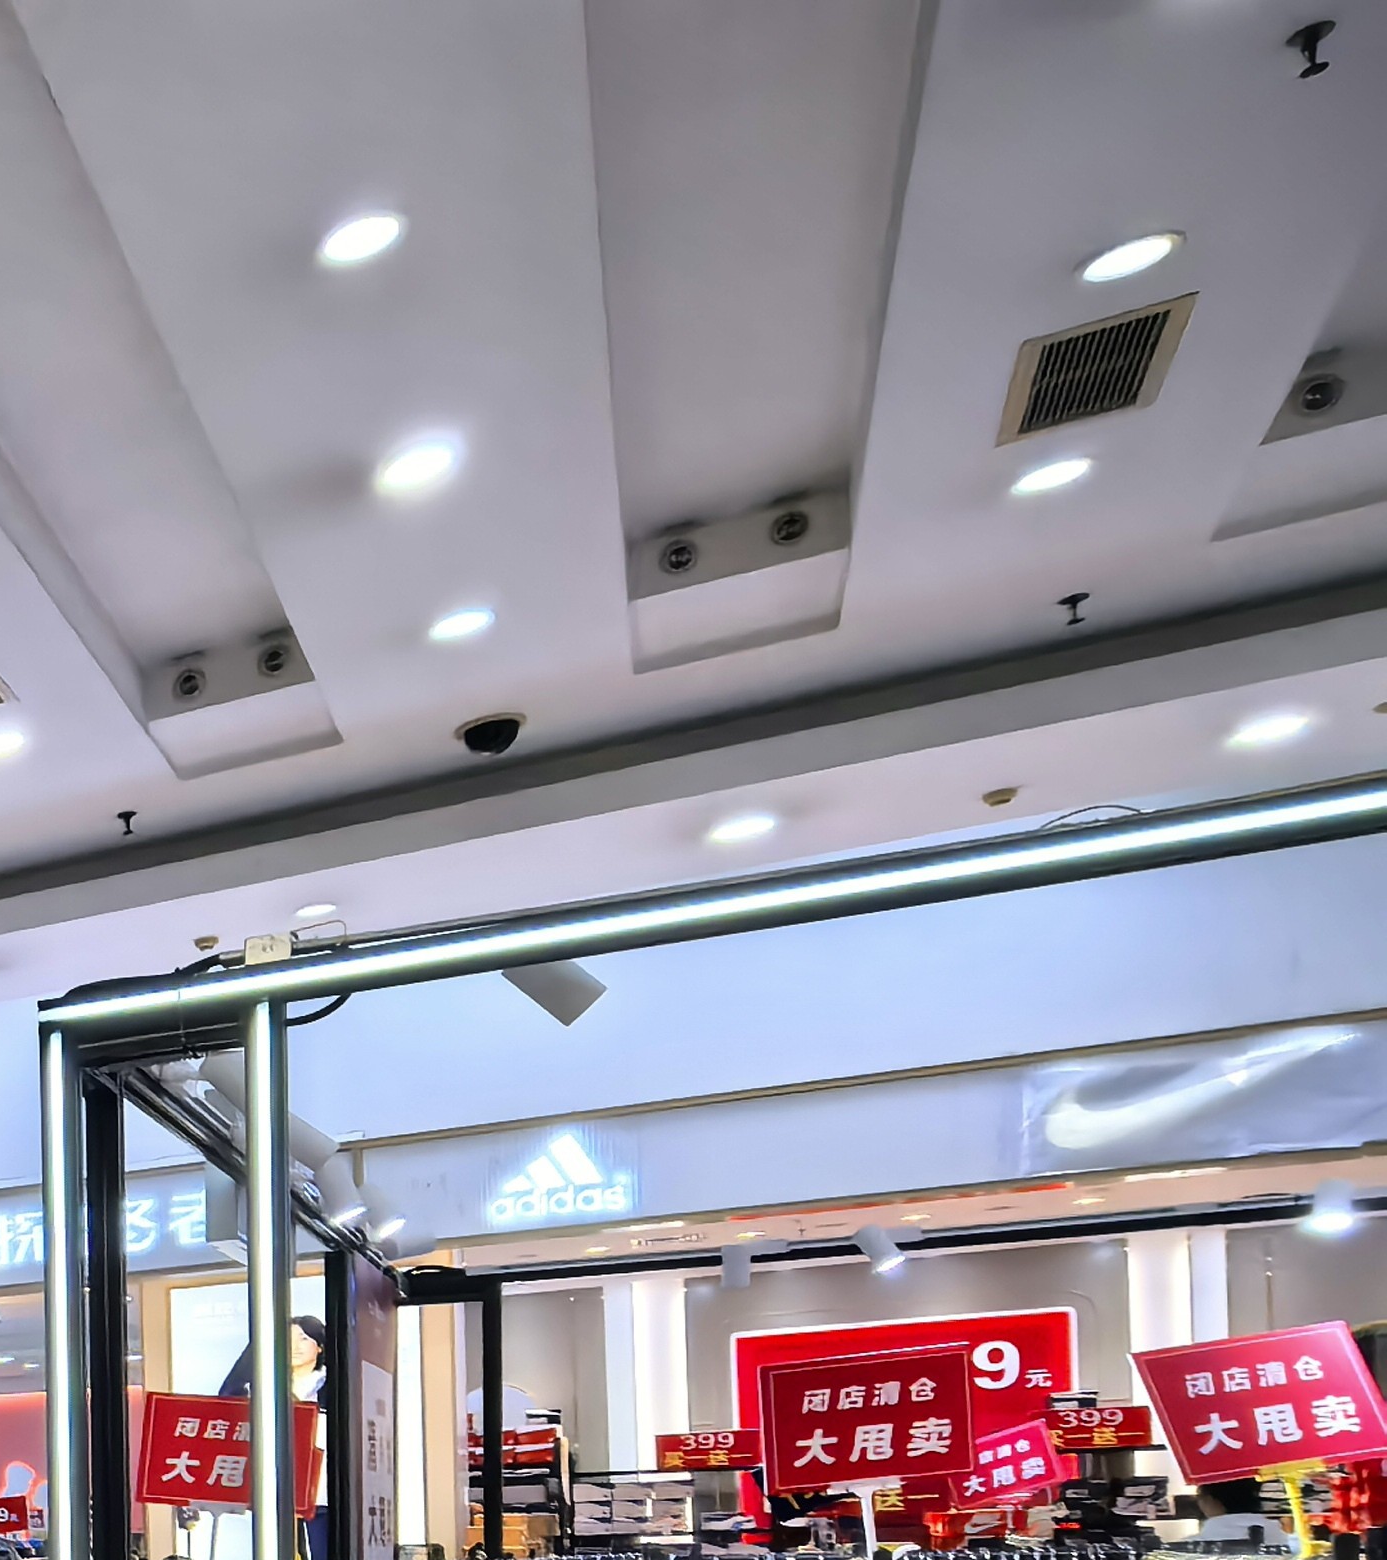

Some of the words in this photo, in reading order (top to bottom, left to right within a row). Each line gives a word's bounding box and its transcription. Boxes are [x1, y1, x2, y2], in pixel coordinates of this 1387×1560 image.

[489, 1183, 627, 1221] adidas
[802, 1377, 939, 1413] 闭店清仓
[1184, 1354, 1326, 1400] 闭店清仓
[1058, 1408, 1125, 1428] 399
[1193, 1394, 1365, 1456] 大甩卖
[663, 1449, 754, 1468] 买一送一
[678, 1432, 735, 1450] 399
[793, 1416, 953, 1469] 大甩卖
[161, 1450, 249, 1488] 大甩
